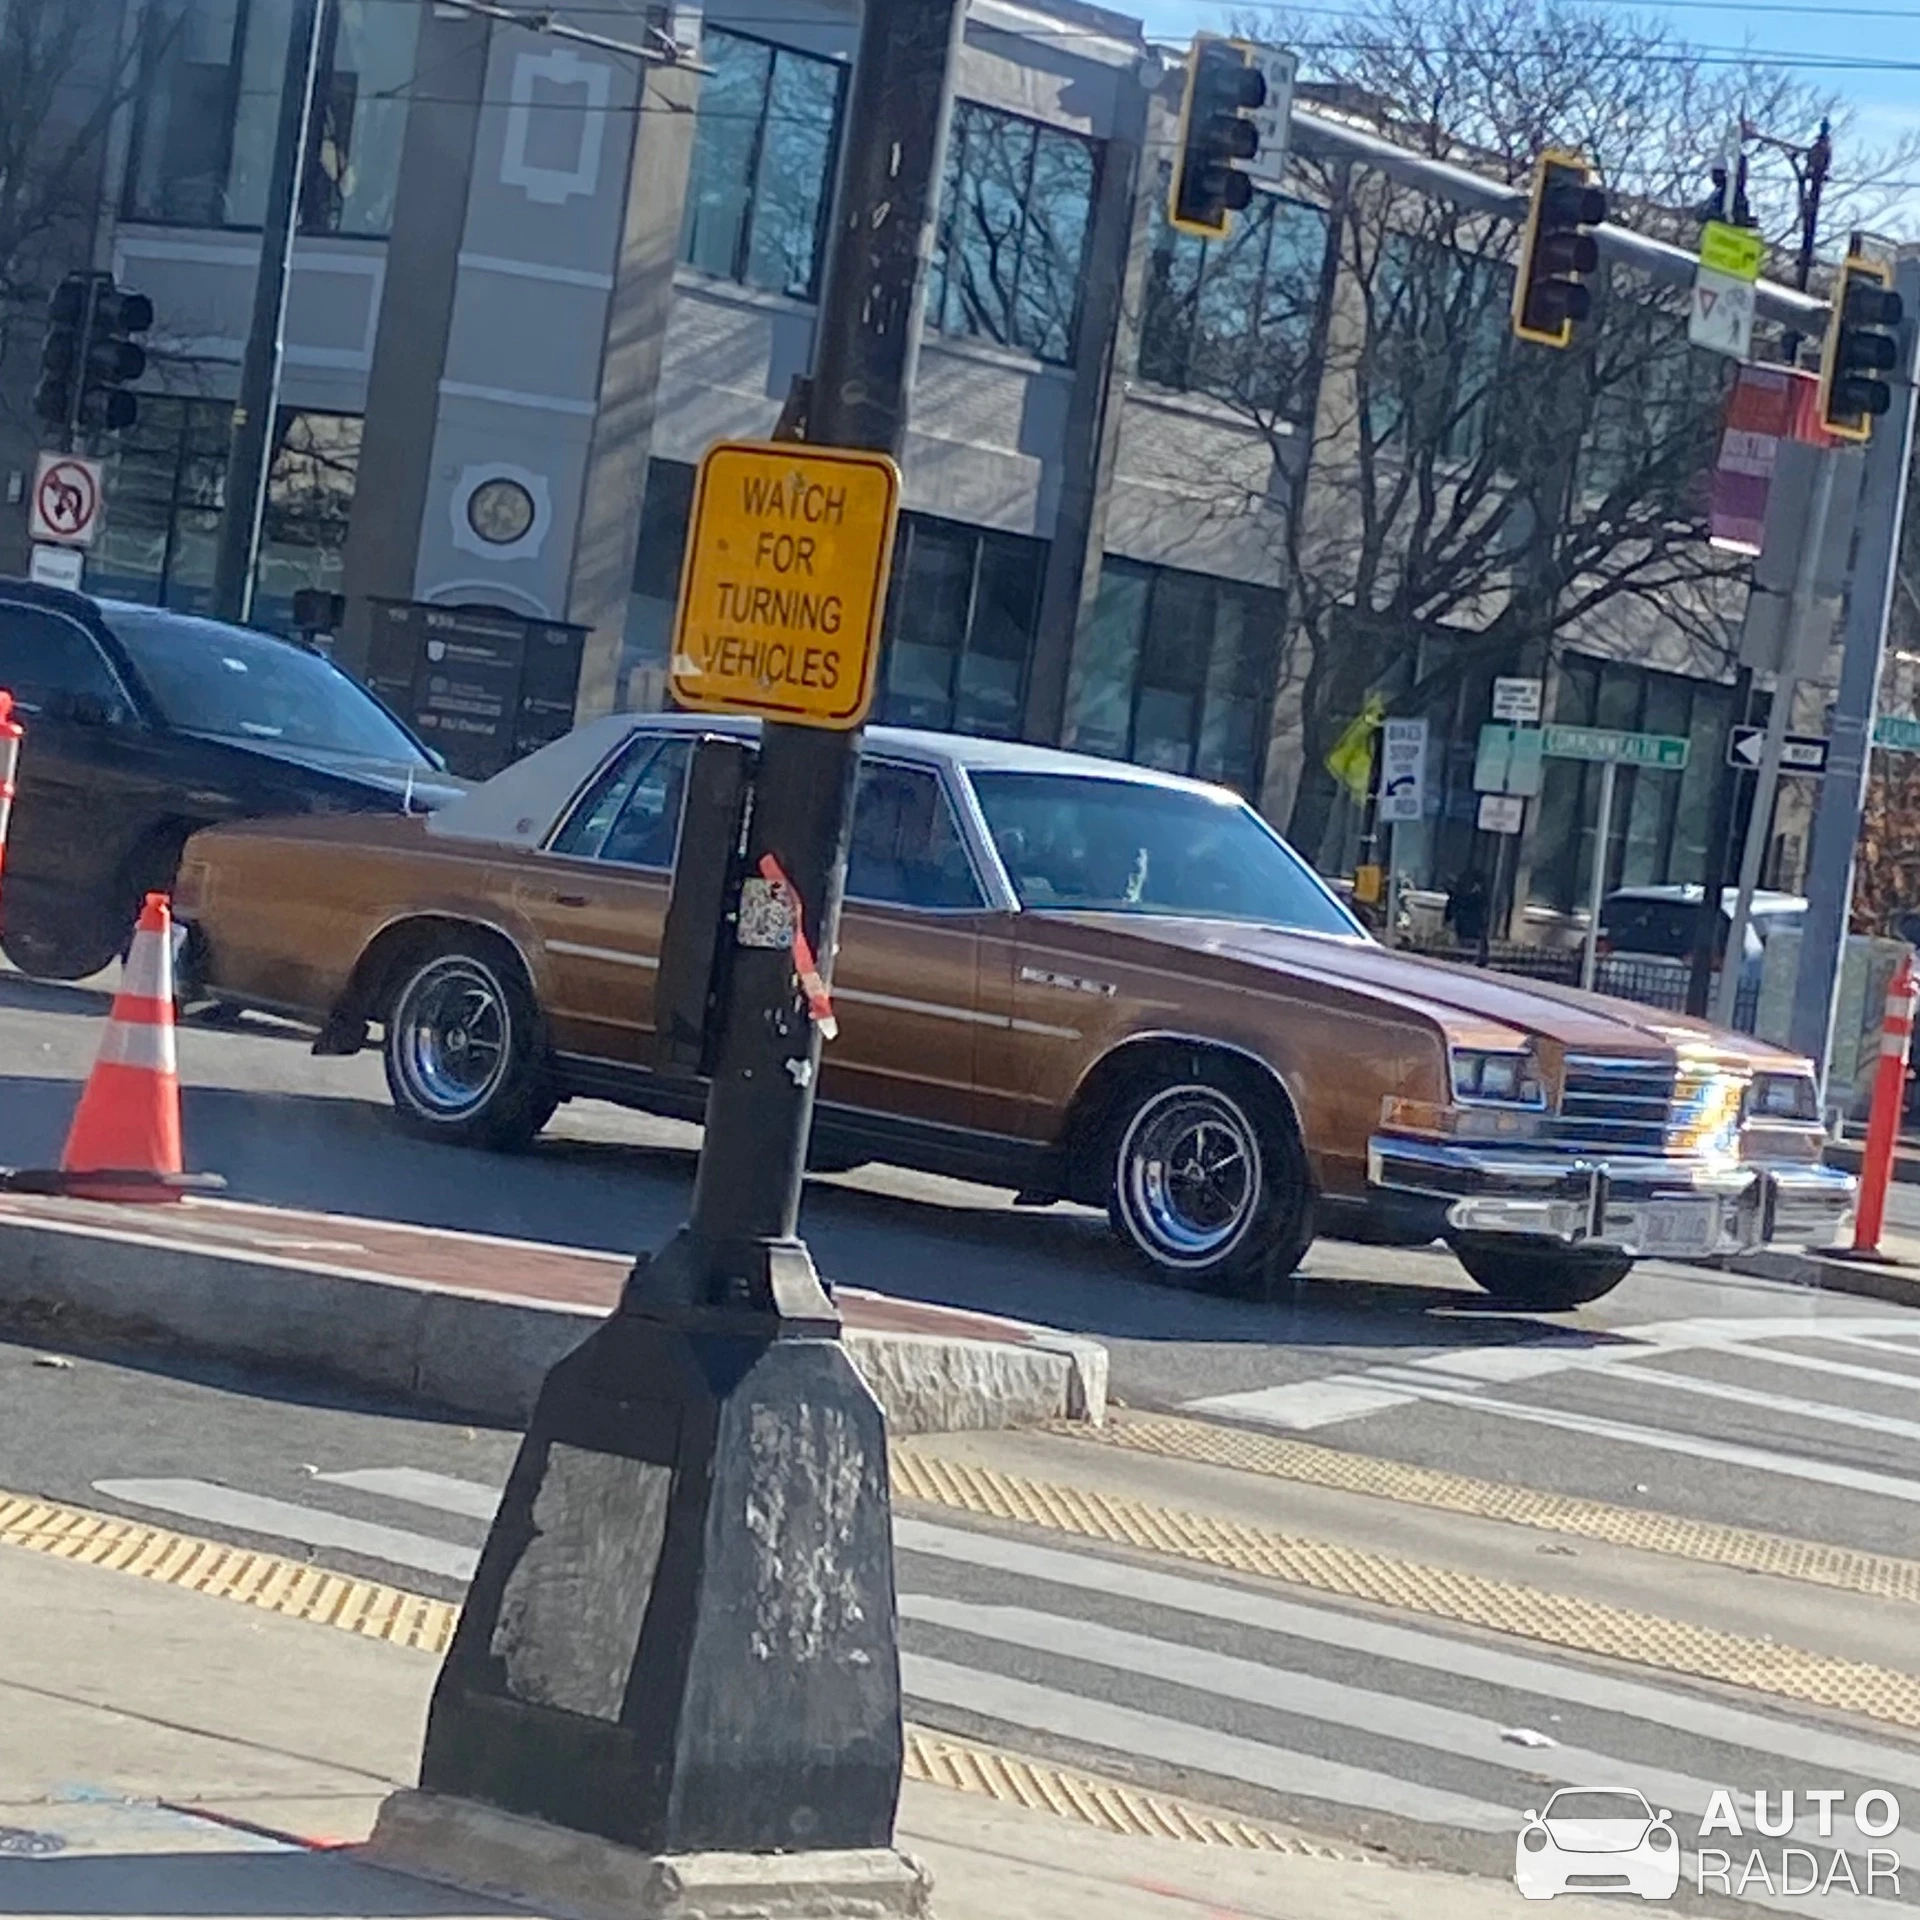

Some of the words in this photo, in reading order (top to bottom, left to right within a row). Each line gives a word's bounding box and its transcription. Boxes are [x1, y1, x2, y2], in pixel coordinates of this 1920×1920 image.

[743, 476, 846, 525] WATCH
[755, 532, 815, 576] FOR
[717, 582, 842, 634] TURNING
[702, 632, 840, 689] VEHICLES
